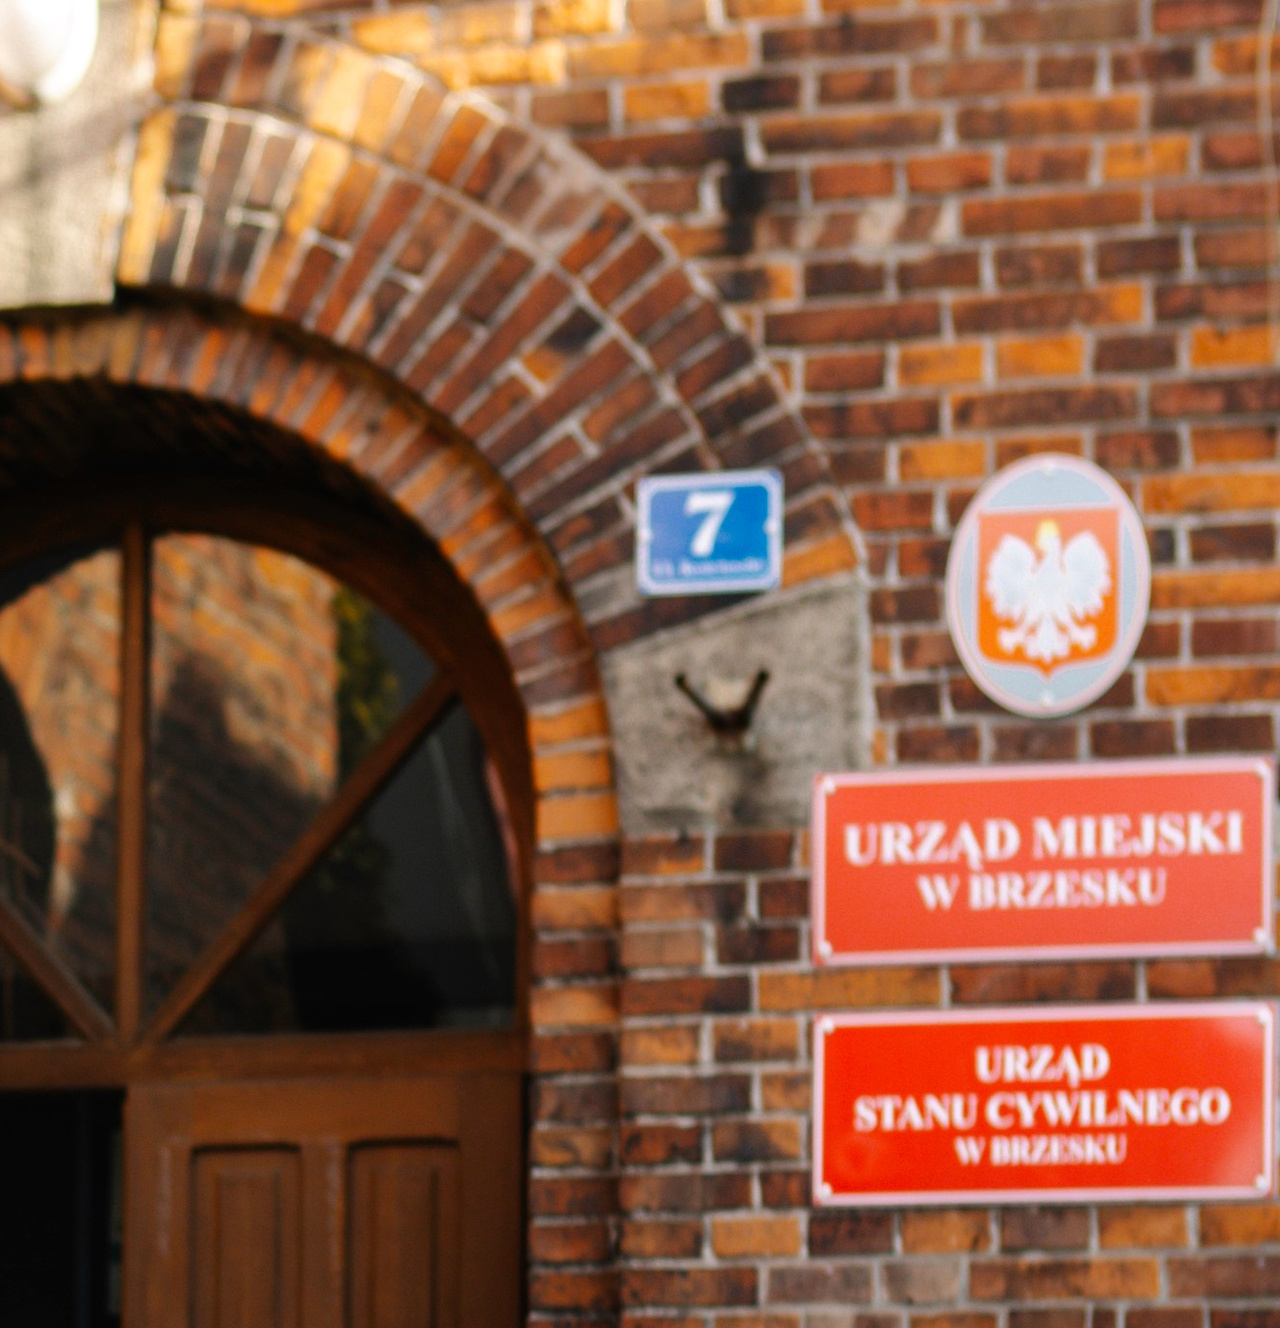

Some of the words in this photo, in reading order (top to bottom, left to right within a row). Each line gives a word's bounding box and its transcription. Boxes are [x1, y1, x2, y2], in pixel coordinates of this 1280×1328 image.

[684, 490, 735, 558] 7
[843, 818, 1020, 871] URZĄD
[1032, 810, 1245, 861] MIEJSKI
[917, 873, 960, 911] W
[969, 868, 1167, 911] BRZESKU
[974, 1042, 1111, 1088] URZĄD
[853, 1092, 978, 1132] STANU
[985, 1086, 1232, 1130] CYWILNEGO
[954, 1136, 986, 1166] W
[990, 1133, 1128, 1167] BRZESKU
